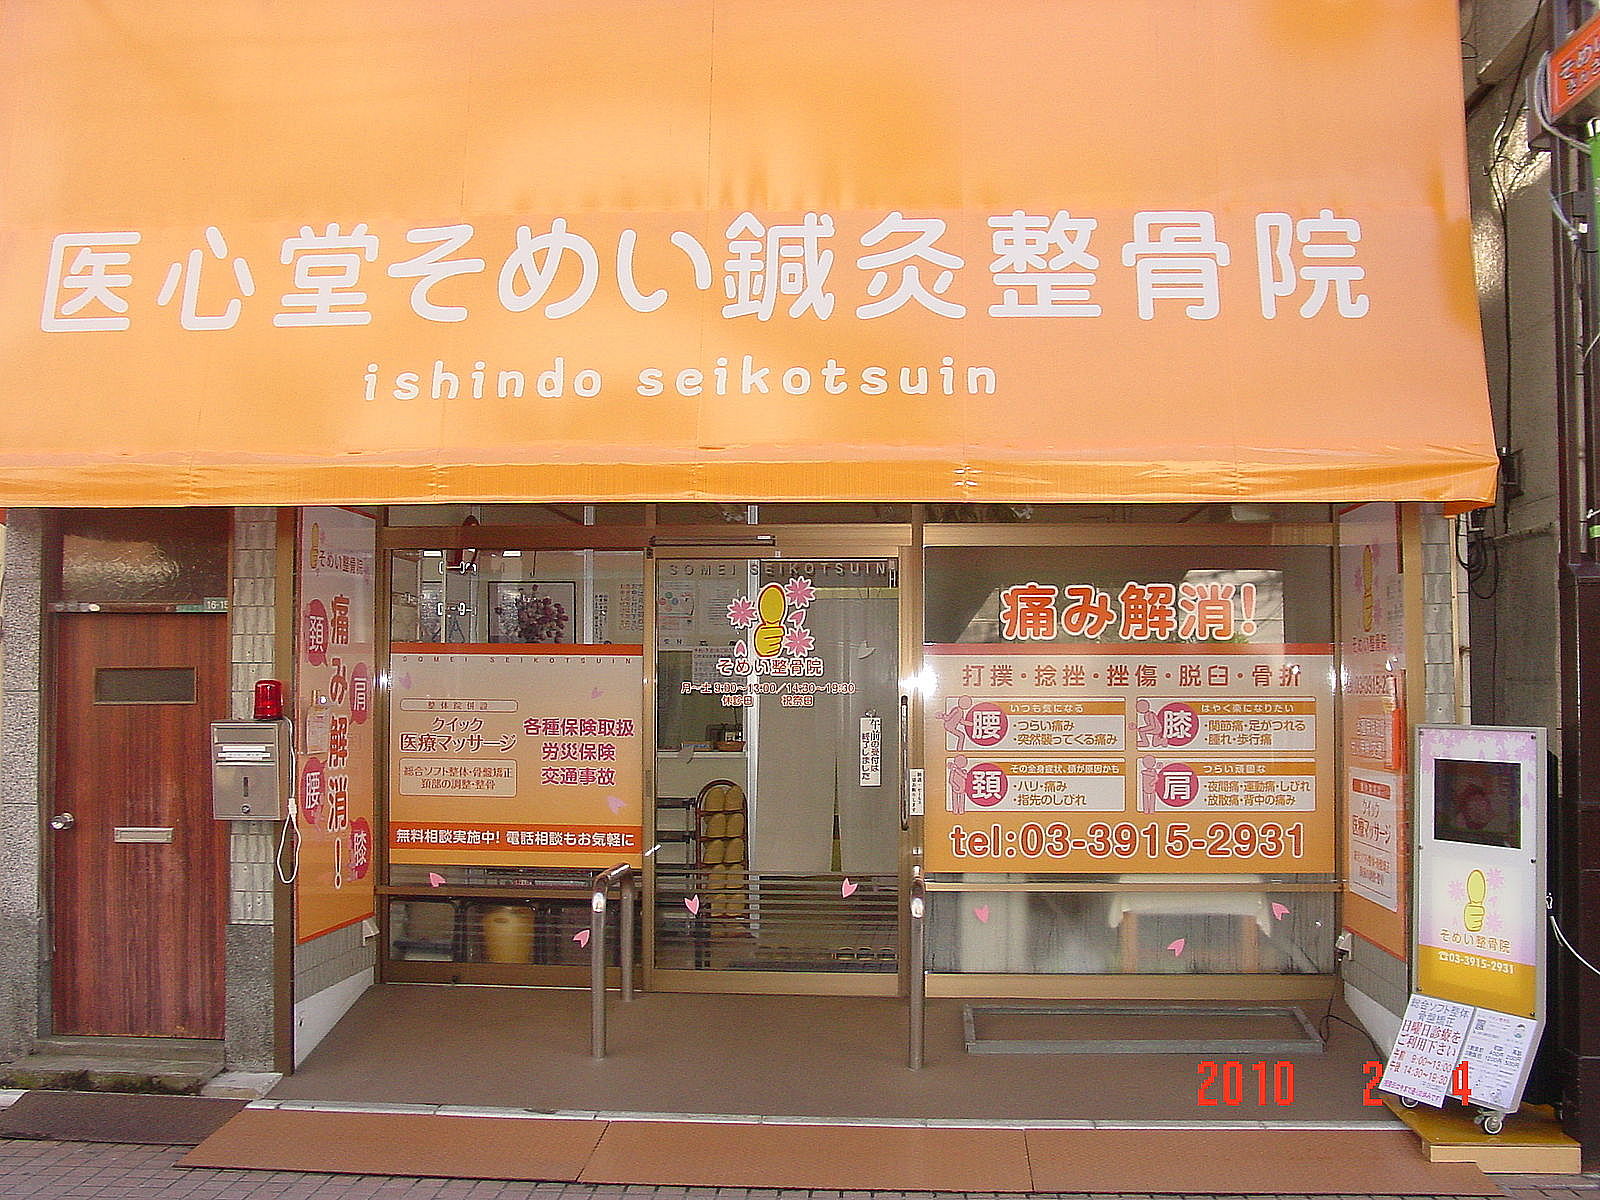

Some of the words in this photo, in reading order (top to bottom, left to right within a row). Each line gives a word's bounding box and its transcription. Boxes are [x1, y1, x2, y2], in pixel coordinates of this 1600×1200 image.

[40, 208, 1370, 334] 医心堂そめい鍼灸整骨院
[364, 357, 602, 401] ishindo
[636, 355, 998, 397] seikotsuin
[1000, 581, 1258, 641] 痛み解消!
[716, 657, 825, 677] そめい整骨院
[432, 716, 484, 732] クイック
[522, 717, 635, 738] 各種保険取扱
[972, 710, 1001, 740] 腰
[1163, 710, 1192, 739] 膝
[399, 733, 517, 753] 医療マッサージ
[541, 742, 617, 762] 労災保険
[541, 766, 617, 787] 交通事故
[1163, 771, 1193, 801] 肩
[396, 828, 500, 844] 無料相談実施中!
[505, 830, 635, 847] 電話相談もお気軽に
[949, 822, 1305, 859] tel:03-3915-2931
[1440, 928, 1512, 955] そめい整骨院
